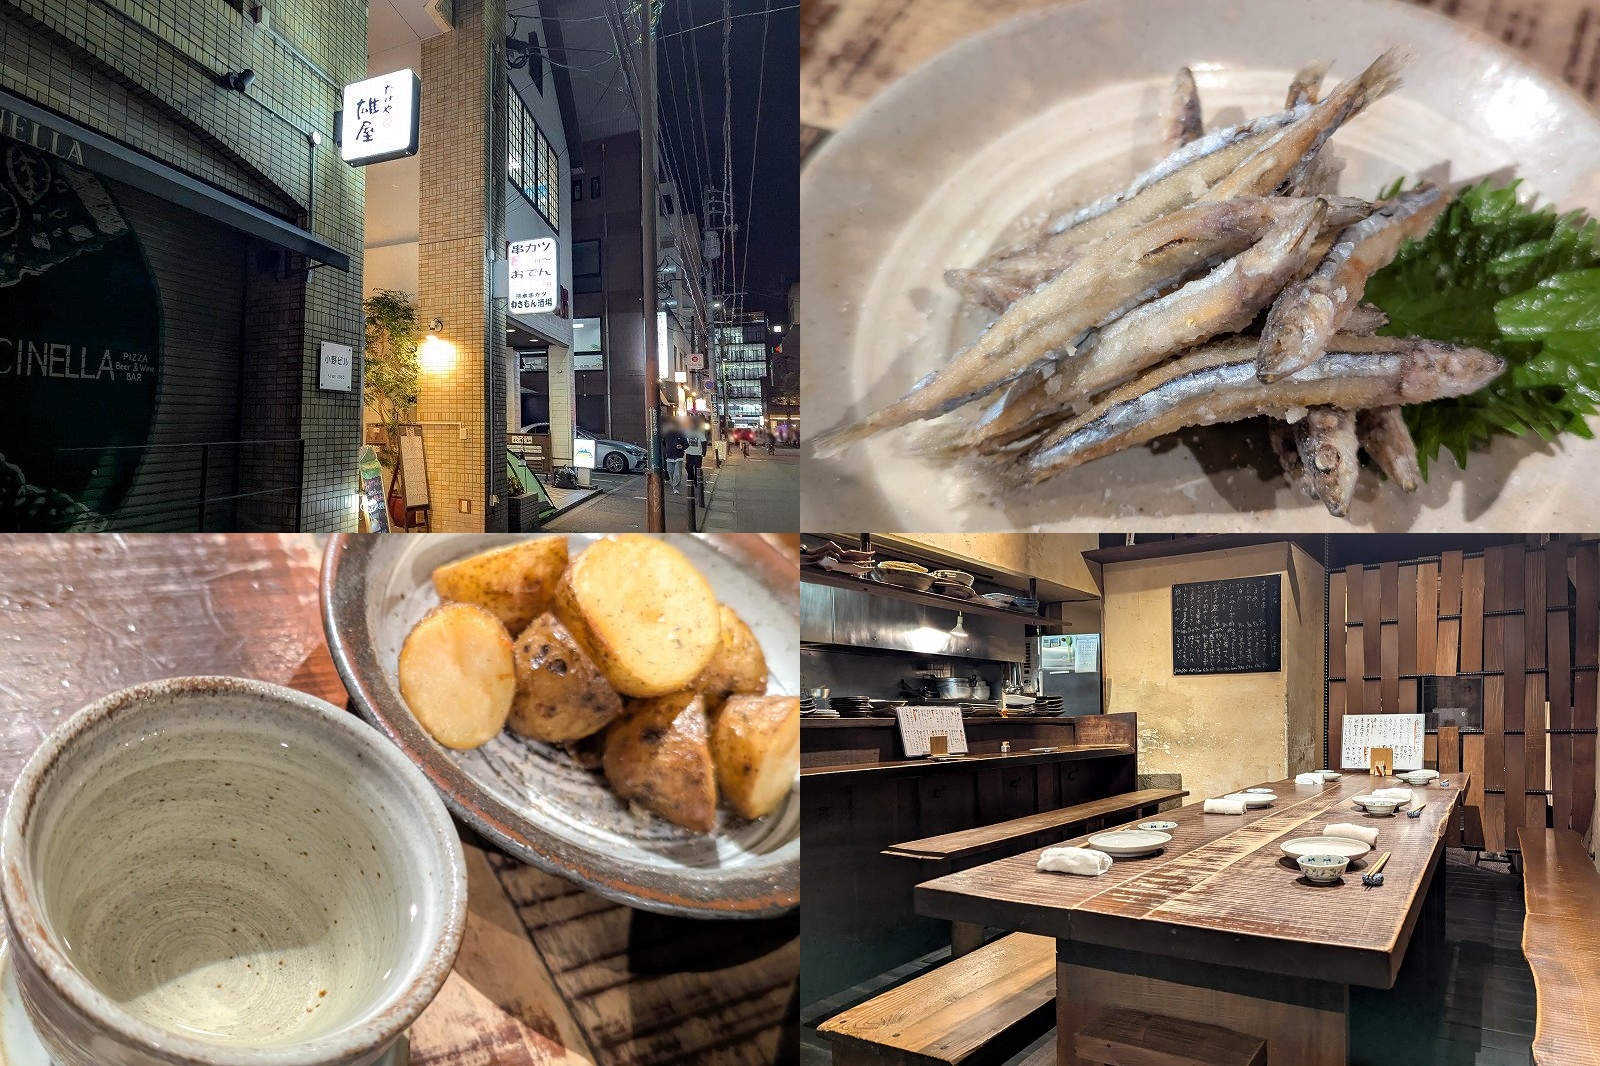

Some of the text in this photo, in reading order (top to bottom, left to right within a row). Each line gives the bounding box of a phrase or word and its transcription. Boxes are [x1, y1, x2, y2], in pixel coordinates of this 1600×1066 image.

[356, 97, 380, 143] 雄屋
[0, 108, 85, 167] ELLA
[511, 241, 551, 255] 串カツ
[510, 267, 552, 280] おでん
[510, 297, 553, 309] わさもん酒場
[123, 352, 148, 362] PIZZA
[324, 354, 349, 367] 小野ビル
[115, 362, 155, 373] Beer & Wine
[126, 373, 142, 382] BAR
